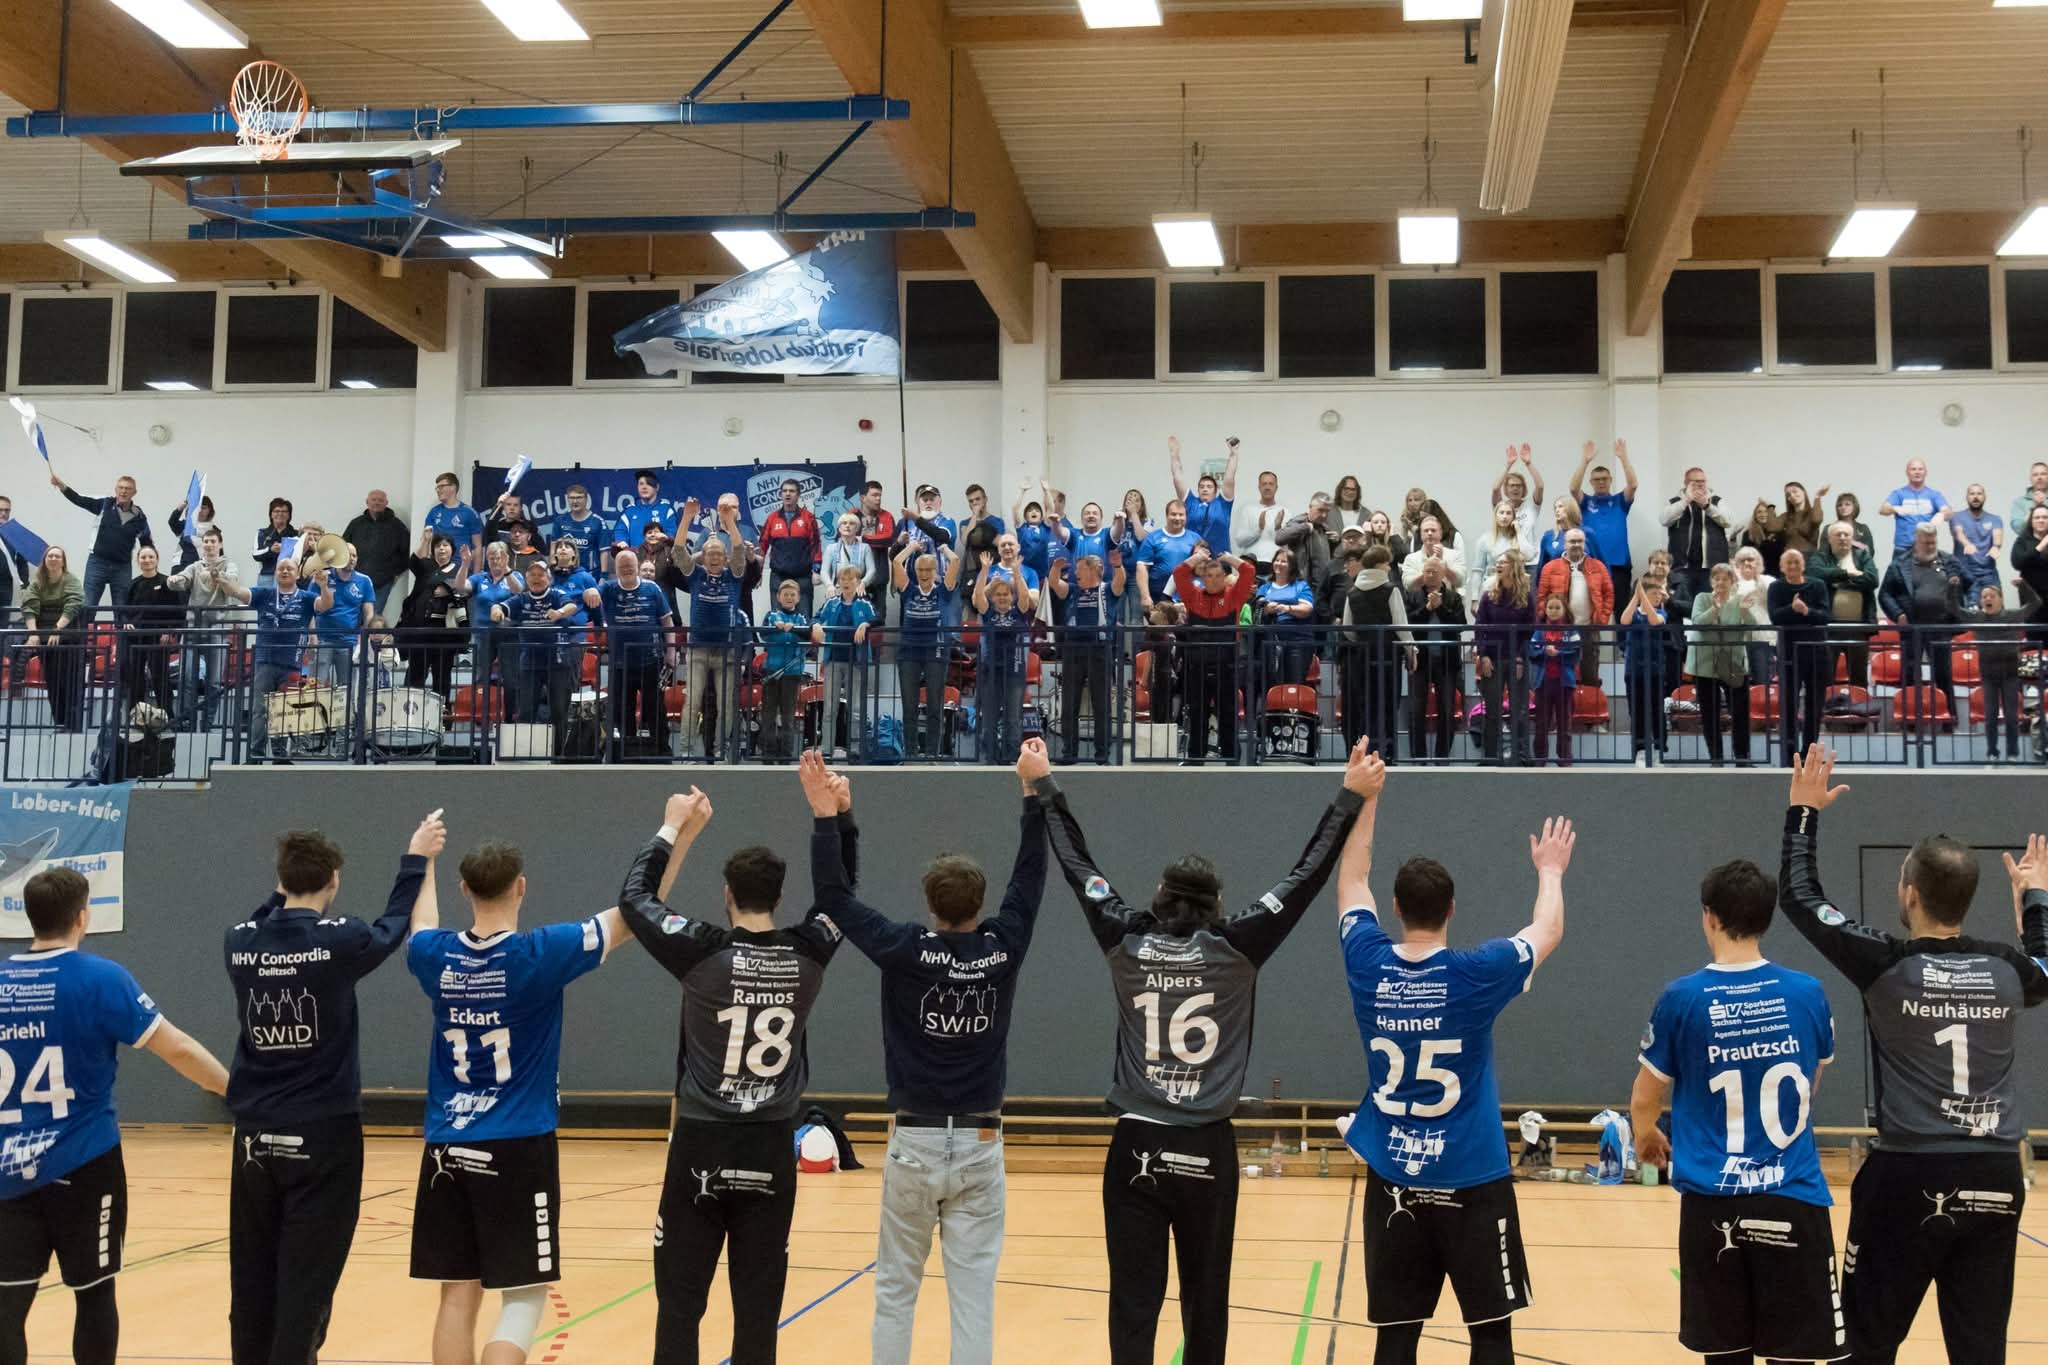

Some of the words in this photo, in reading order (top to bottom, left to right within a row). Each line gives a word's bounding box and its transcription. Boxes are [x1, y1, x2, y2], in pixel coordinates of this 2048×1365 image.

[752, 479, 818, 507] CONCDIA
[756, 475, 780, 492] NHV
[232, 952, 258, 966] NHV
[261, 947, 331, 966] Concordia
[920, 950, 951, 965] NHV
[258, 966, 297, 977] Delitzsch
[1145, 973, 1203, 992] Alpers
[733, 988, 794, 1005] Ramos
[1743, 997, 1785, 1009] Sparkassen
[449, 1007, 501, 1025] Eckart
[1741, 1005, 1786, 1017] Versicherung
[1901, 999, 2010, 1019] Neuhäuser
[0, 1021, 45, 1041] Griehl
[925, 1012, 989, 1033] SWiD
[1132, 991, 1220, 1065] 16
[1376, 1015, 1442, 1032] Hanner
[1711, 1018, 1742, 1028] Sachsen
[253, 1025, 313, 1045] SWiD
[717, 1005, 795, 1078] 18
[1714, 1030, 1742, 1039] Agentur
[443, 1027, 512, 1085] 11
[1708, 1034, 1800, 1064] Prautzsch
[1934, 1023, 1969, 1096] 1
[0, 1046, 75, 1124] 24
[1369, 1037, 1462, 1118] 25
[1708, 1061, 1811, 1154] 10
